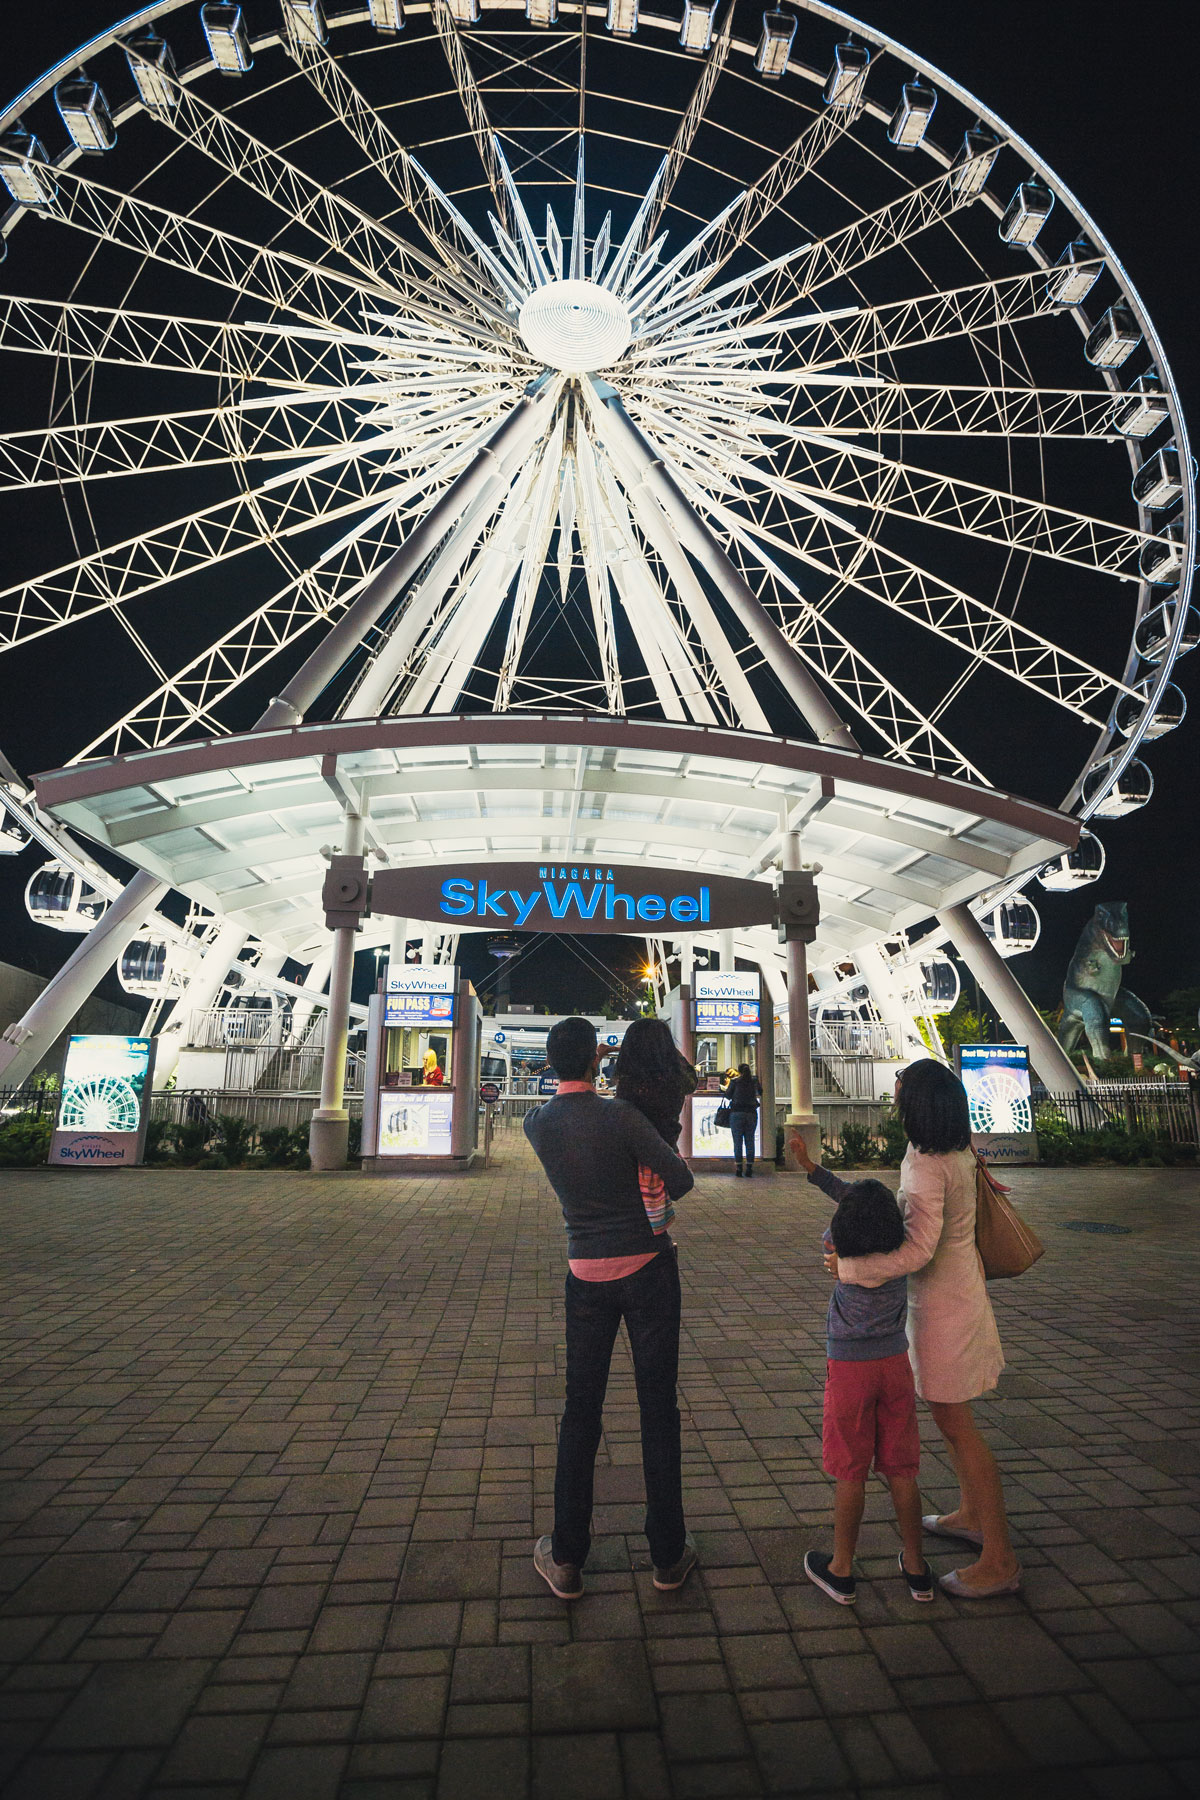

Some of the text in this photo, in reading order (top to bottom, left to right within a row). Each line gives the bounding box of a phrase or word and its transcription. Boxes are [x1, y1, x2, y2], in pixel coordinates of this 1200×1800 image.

[539, 866, 614, 881] NIAGARA
[439, 878, 710, 926] SkyWheel
[390, 980, 447, 990] SkyWheel
[700, 986, 754, 997] SkyWheel
[387, 998, 430, 1011] FUN PASS
[697, 1004, 740, 1017] FUN PASS
[60, 1147, 125, 1160] SkyWheel
[977, 1147, 1030, 1159] SkyWheel
